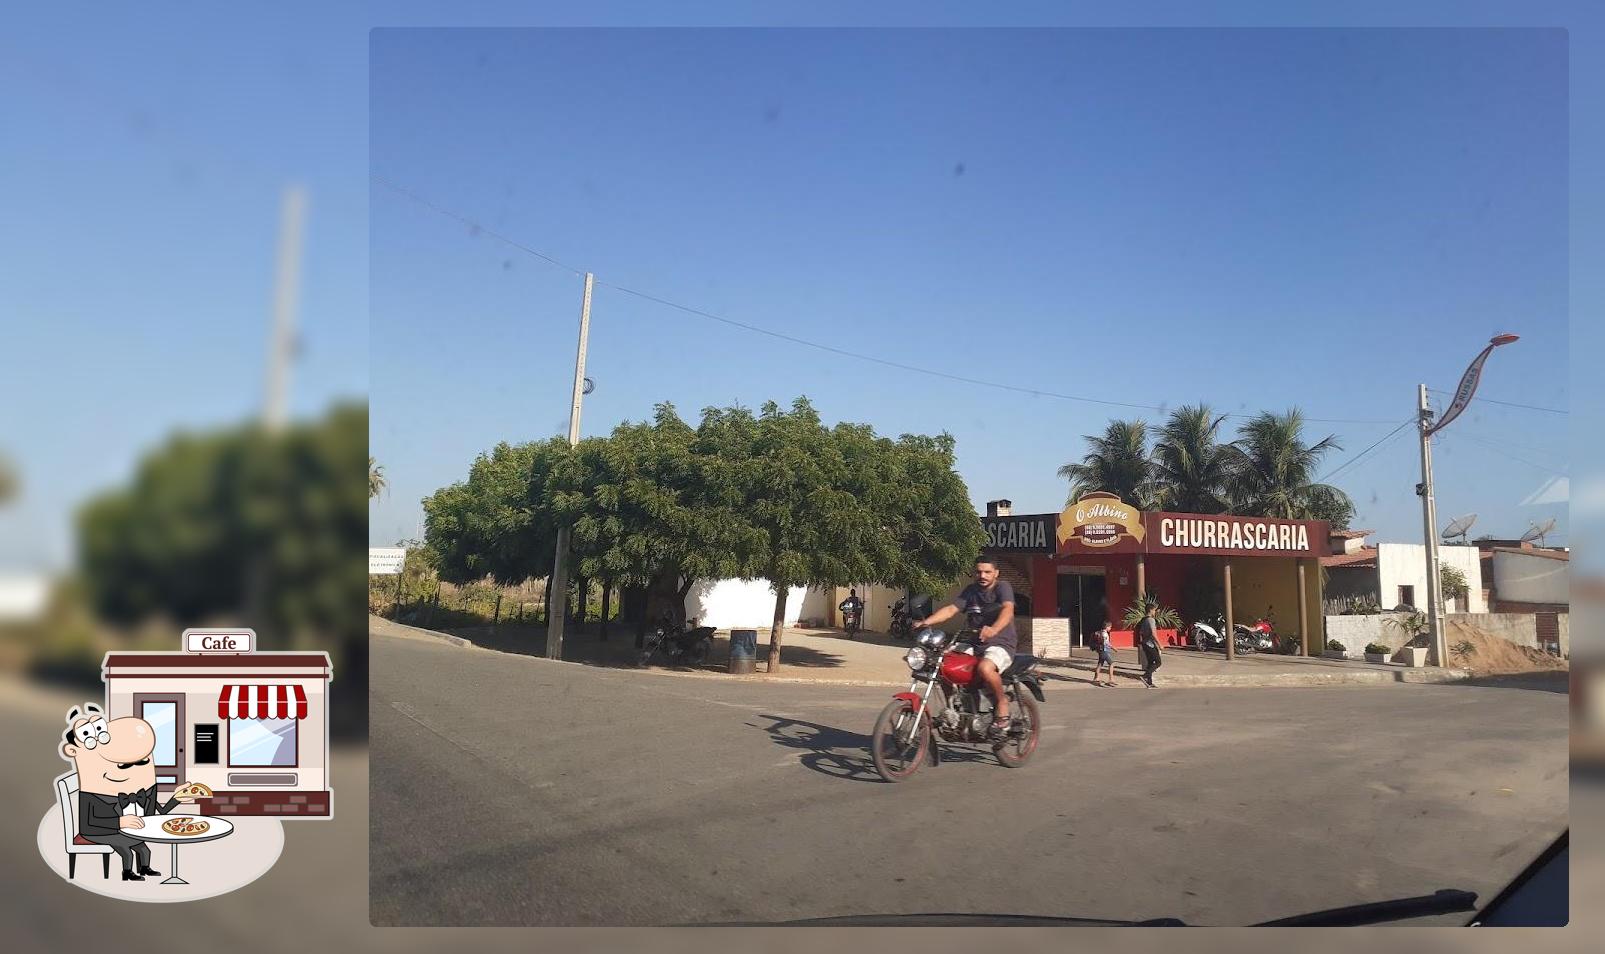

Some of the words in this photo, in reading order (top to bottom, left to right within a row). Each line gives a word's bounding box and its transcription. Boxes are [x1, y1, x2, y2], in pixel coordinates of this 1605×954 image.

[1076, 507, 1085, 522] O
[1086, 503, 1129, 520] Albino
[1160, 517, 1310, 551] CHURRASCARIA
